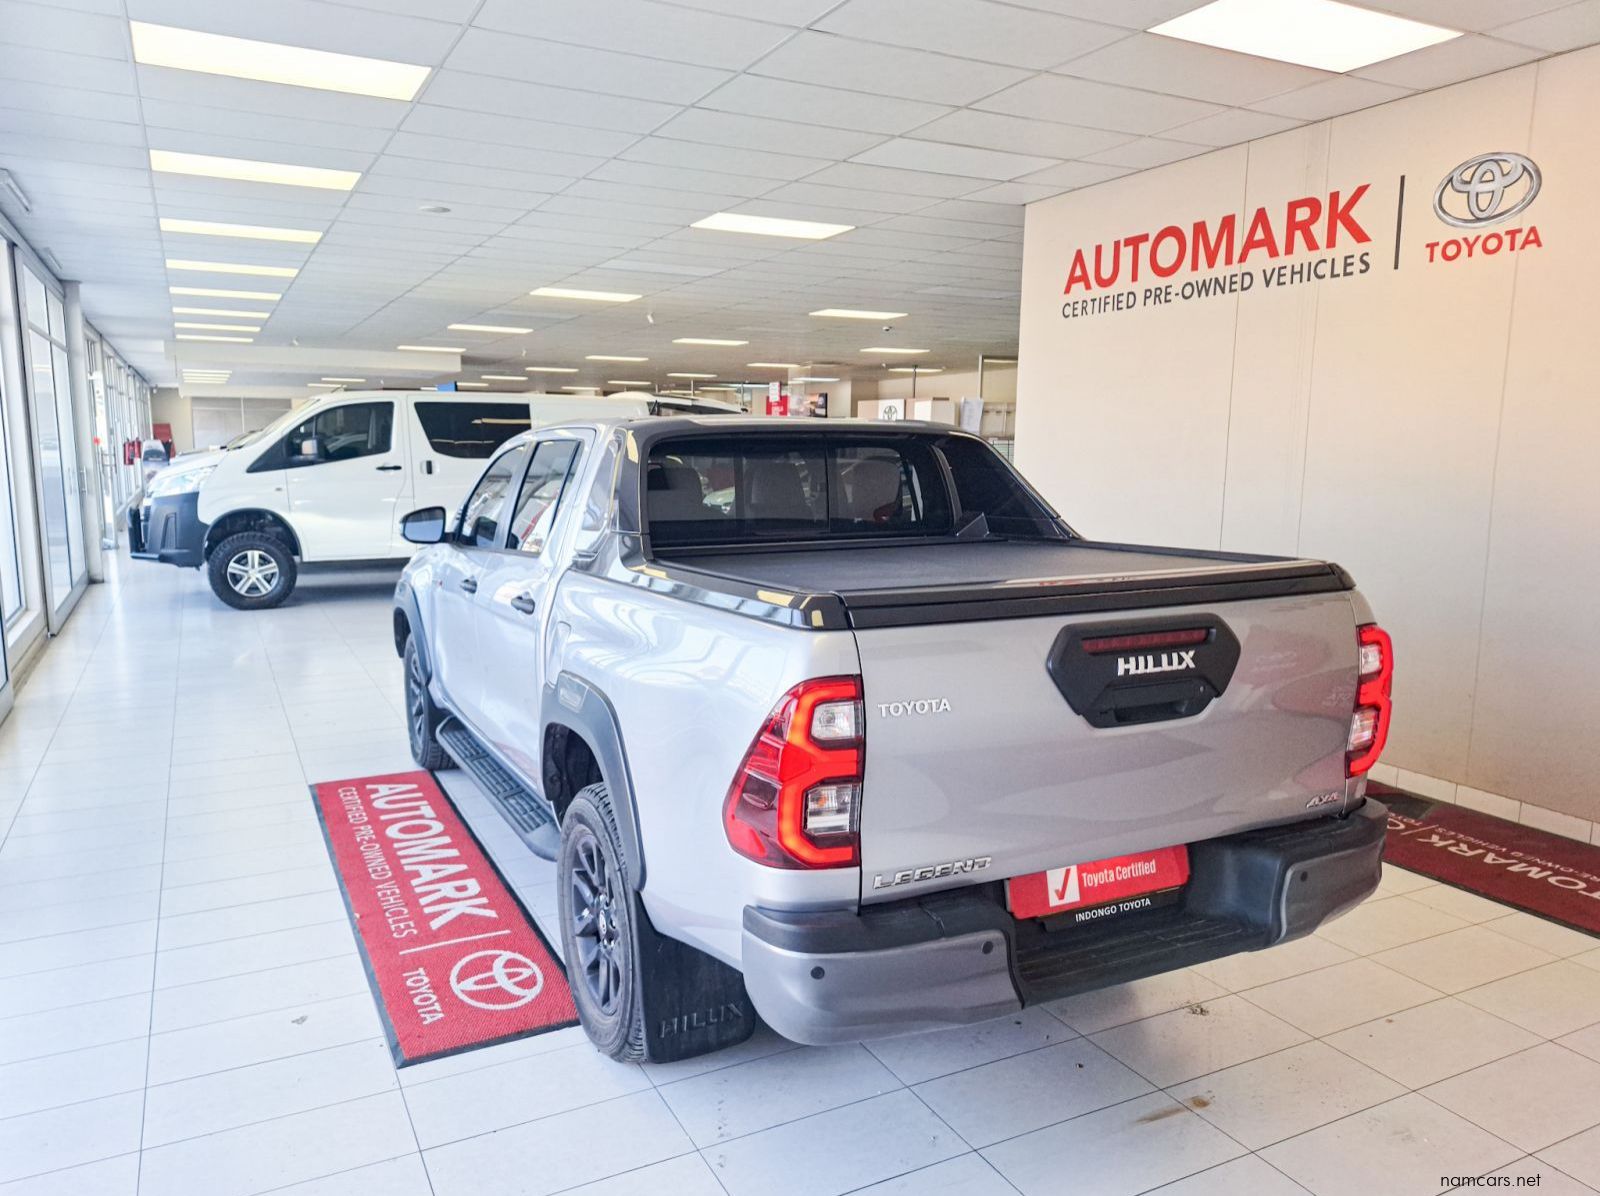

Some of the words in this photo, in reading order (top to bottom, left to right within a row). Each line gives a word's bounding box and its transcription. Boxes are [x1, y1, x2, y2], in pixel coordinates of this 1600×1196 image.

[1063, 184, 1372, 295] AUTOMARK
[1425, 226, 1543, 263] TOYOTA
[1062, 290, 1137, 319] CERTIFIED
[1143, 271, 1254, 307] PRE-OWNED
[1262, 251, 1371, 288] VEHICLES
[1117, 650, 1196, 677] HILUX
[877, 698, 952, 718] TOYOTA
[337, 786, 369, 825] CERTIFIED
[353, 823, 393, 880] PRE-OWNED
[375, 880, 418, 939] VEHICLES
[366, 783, 499, 931] AUTOMARK
[873, 856, 993, 889] LEGEND
[1081, 868, 1115, 888] Toyota
[1116, 858, 1157, 881] Certified
[1075, 904, 1118, 922] INDONGO
[1119, 897, 1152, 913] TOYOTA
[402, 966, 445, 1025] TOYOTA
[660, 1002, 744, 1038] HILUX
